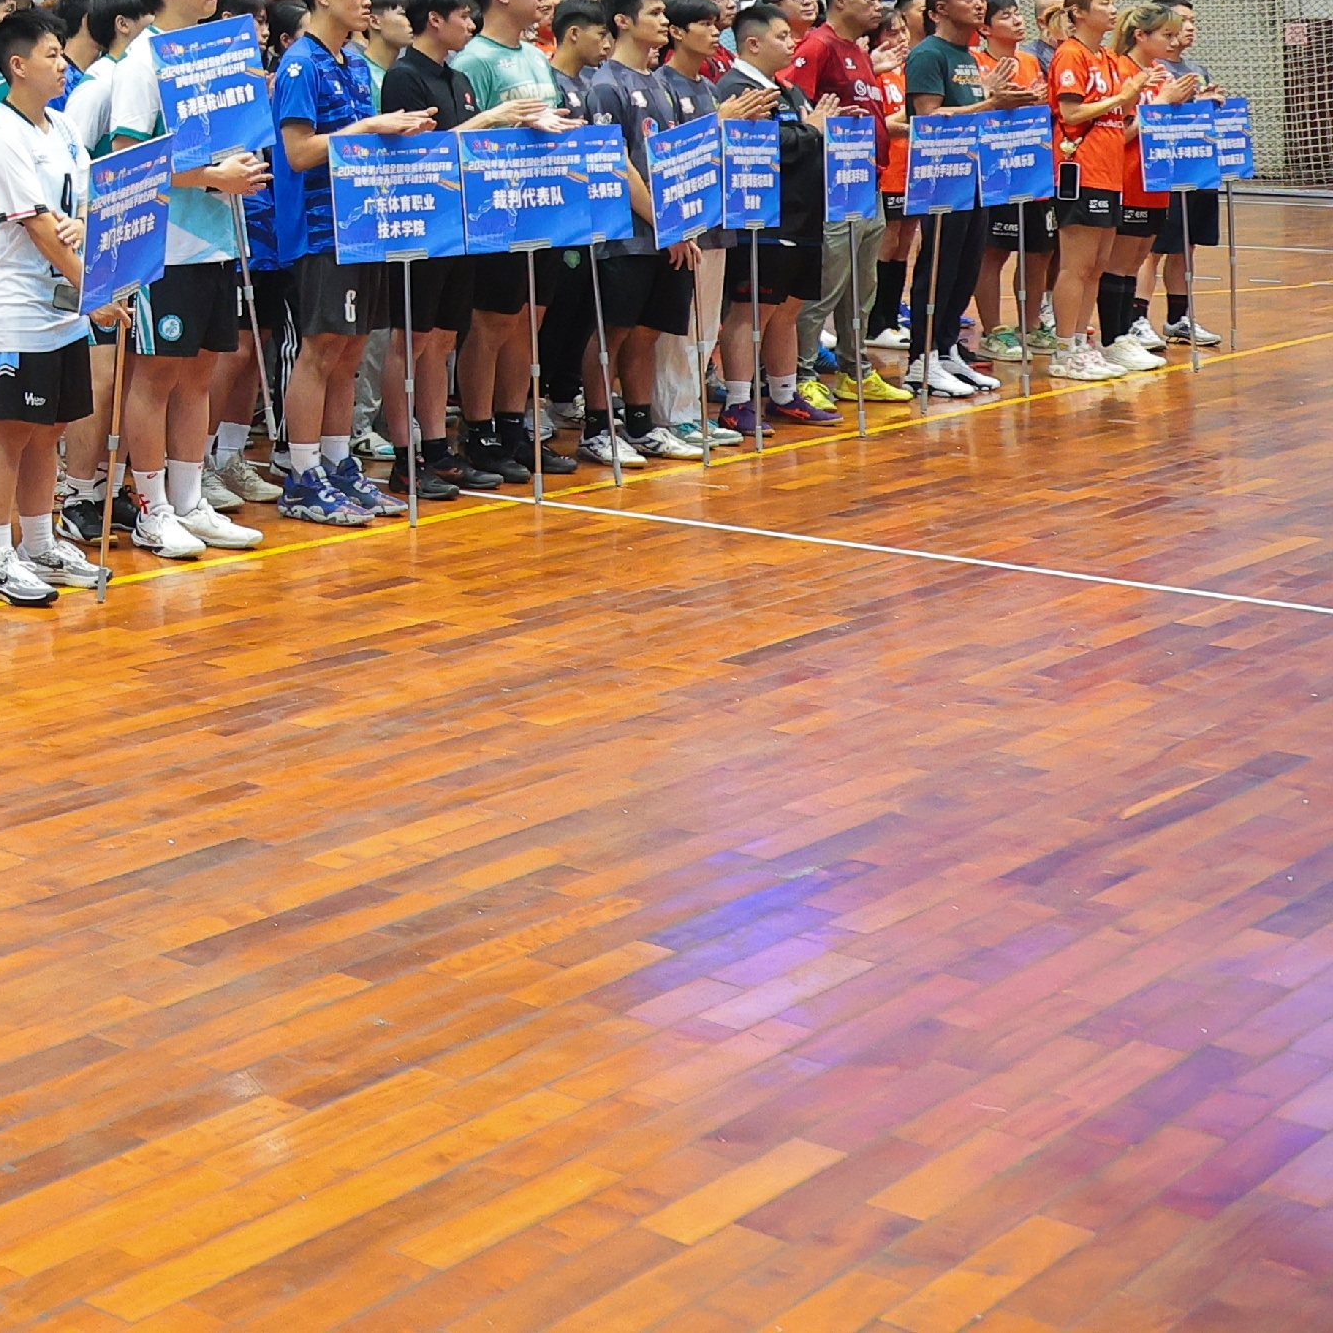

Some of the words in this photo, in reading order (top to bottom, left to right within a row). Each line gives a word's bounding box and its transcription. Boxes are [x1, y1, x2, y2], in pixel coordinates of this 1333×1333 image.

[364, 194, 436, 214] 广东体育职业
[493, 185, 565, 209] 裁判代表队
[378, 219, 426, 239] 技术学院
